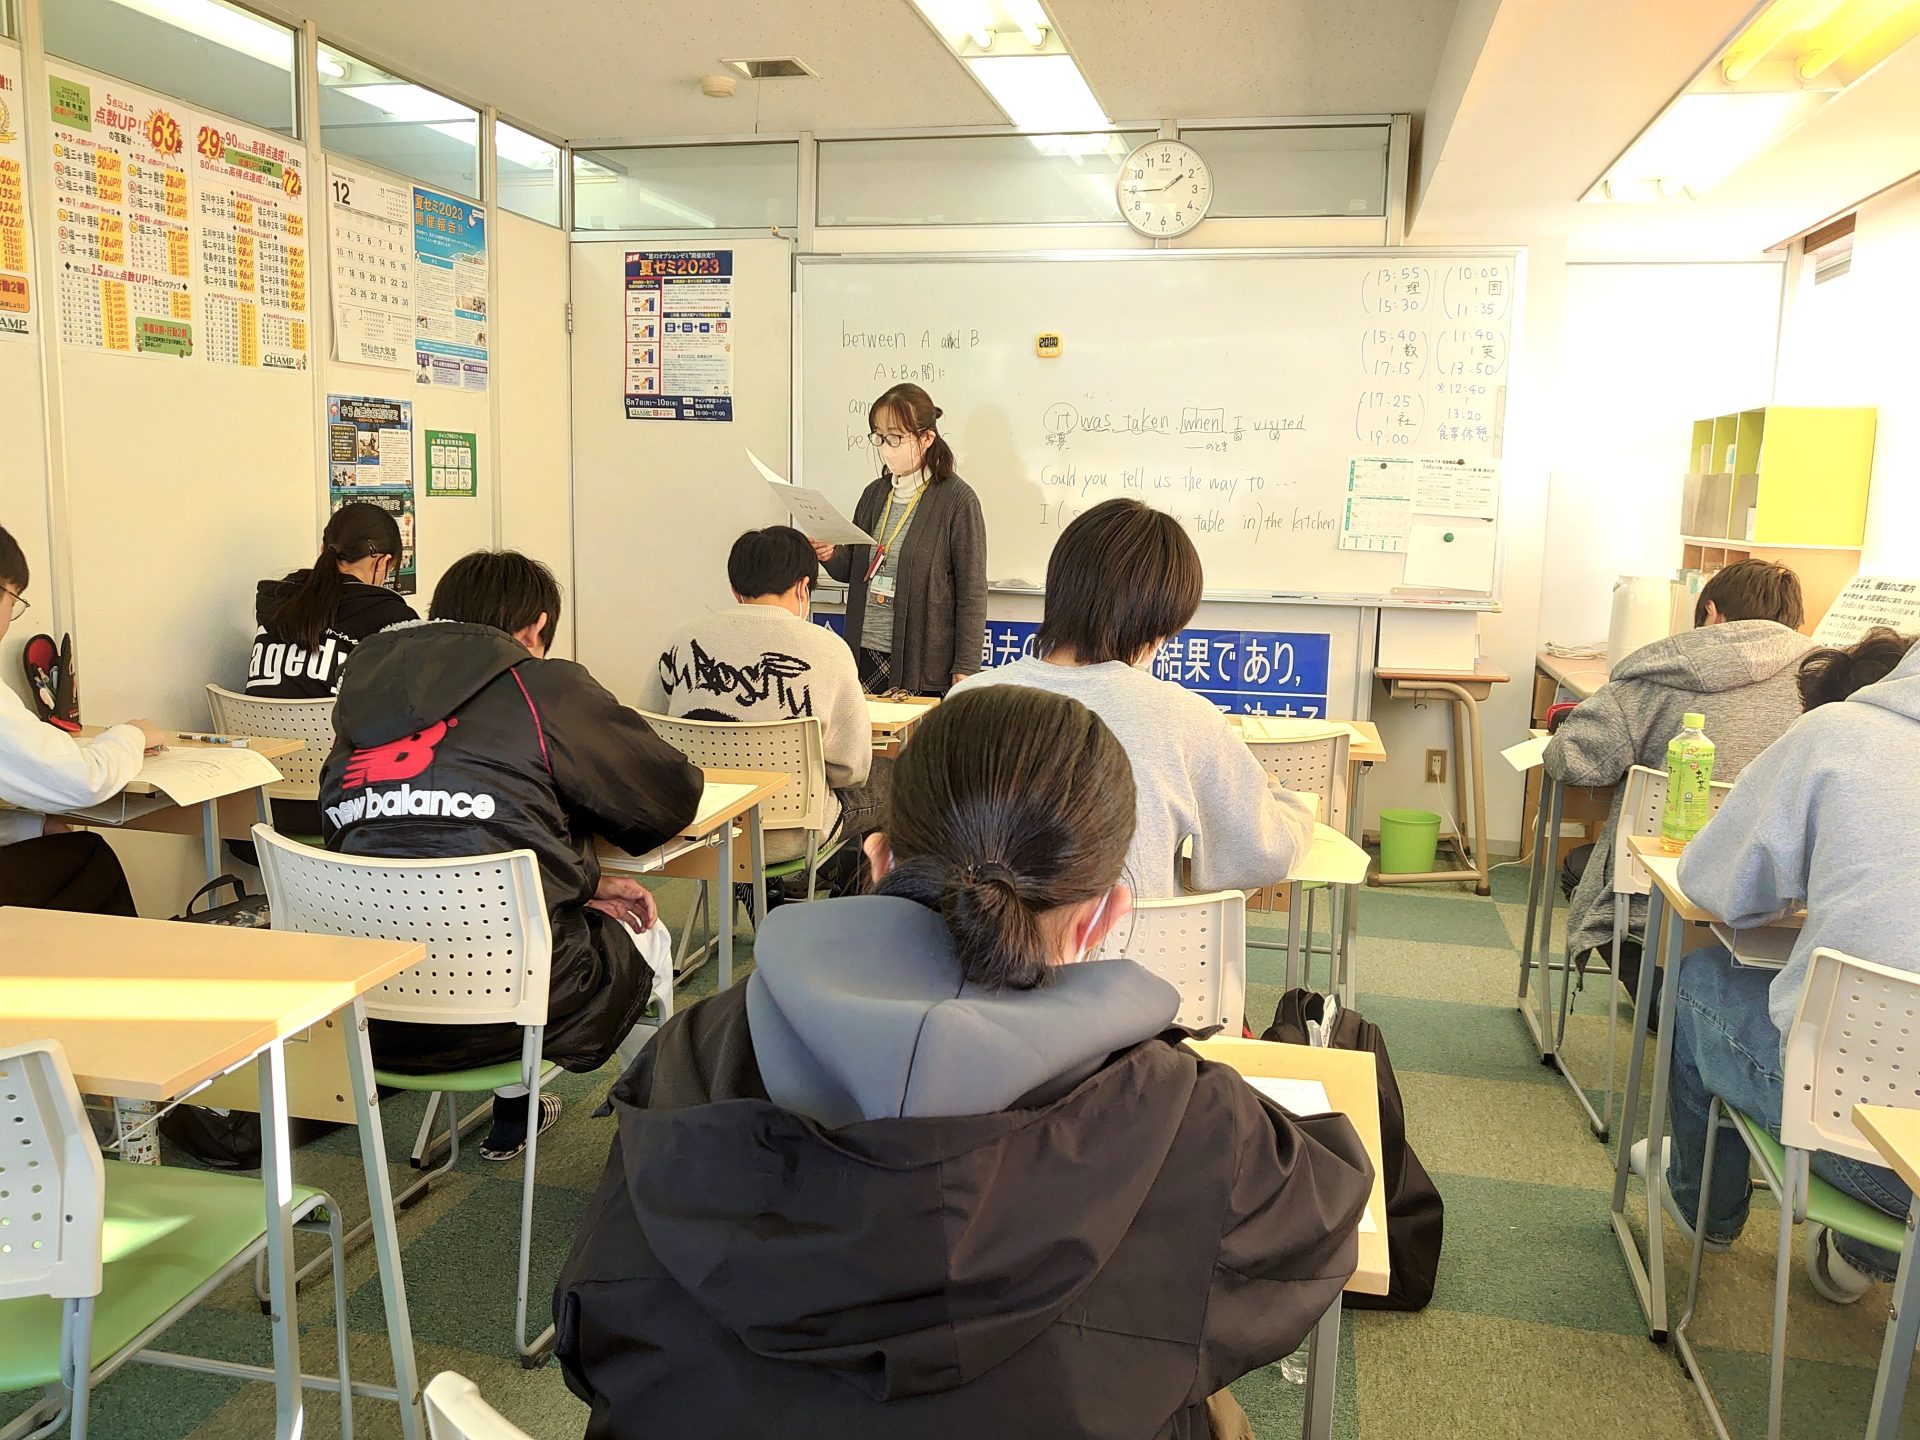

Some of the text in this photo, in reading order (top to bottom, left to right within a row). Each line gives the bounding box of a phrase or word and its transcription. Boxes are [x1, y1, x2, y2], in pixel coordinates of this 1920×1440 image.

[1147, 158, 1154, 168] 11
[1161, 154, 1170, 164] 12
[1135, 170, 1144, 179] 10
[1188, 169, 1194, 178] 2
[333, 180, 350, 206] 12
[1192, 184, 1198, 194] 3
[1135, 201, 1140, 210] 8
[1187, 200, 1192, 210] 4
[1146, 212, 1151, 222] 7
[1160, 216, 1166, 226] 6
[1176, 212, 1182, 222] 5
[348, 250, 354, 258] 11
[368, 256, 374, 264] 13
[380, 258, 385, 266] 14
[338, 266, 344, 274] 17
[370, 274, 376, 282] 20
[1378, 266, 1420, 286] 13:55
[350, 288, 356, 296] 25
[360, 290, 366, 298] 26
[402, 298, 408, 306] 30
[1378, 298, 1418, 312] 15:30
[1458, 303, 1494, 317] 11:35
[841, 318, 906, 348] between
[921, 330, 930, 348] A
[970, 330, 979, 347] B
[1373, 330, 1416, 344] 15:40
[1454, 329, 1494, 342] 11:40
[1403, 344, 1418, 358] 数
[1482, 346, 1496, 359] 英
[264, 354, 294, 366] CHAMP
[874, 363, 946, 383] AとBの間に
[1451, 362, 1494, 376] 13:50
[1080, 414, 1112, 429] was
[1122, 407, 1168, 432] taken
[1184, 408, 1219, 432] when
[1233, 416, 1243, 431] I
[1254, 415, 1304, 430] visited
[1397, 412, 1416, 427] 社
[1448, 408, 1482, 420] 13:20
[1437, 422, 1490, 442] 食事休憩
[1041, 464, 1264, 502] Could you tell us the way to
[1194, 508, 1224, 533] table
[1292, 507, 1335, 532] kitchen
